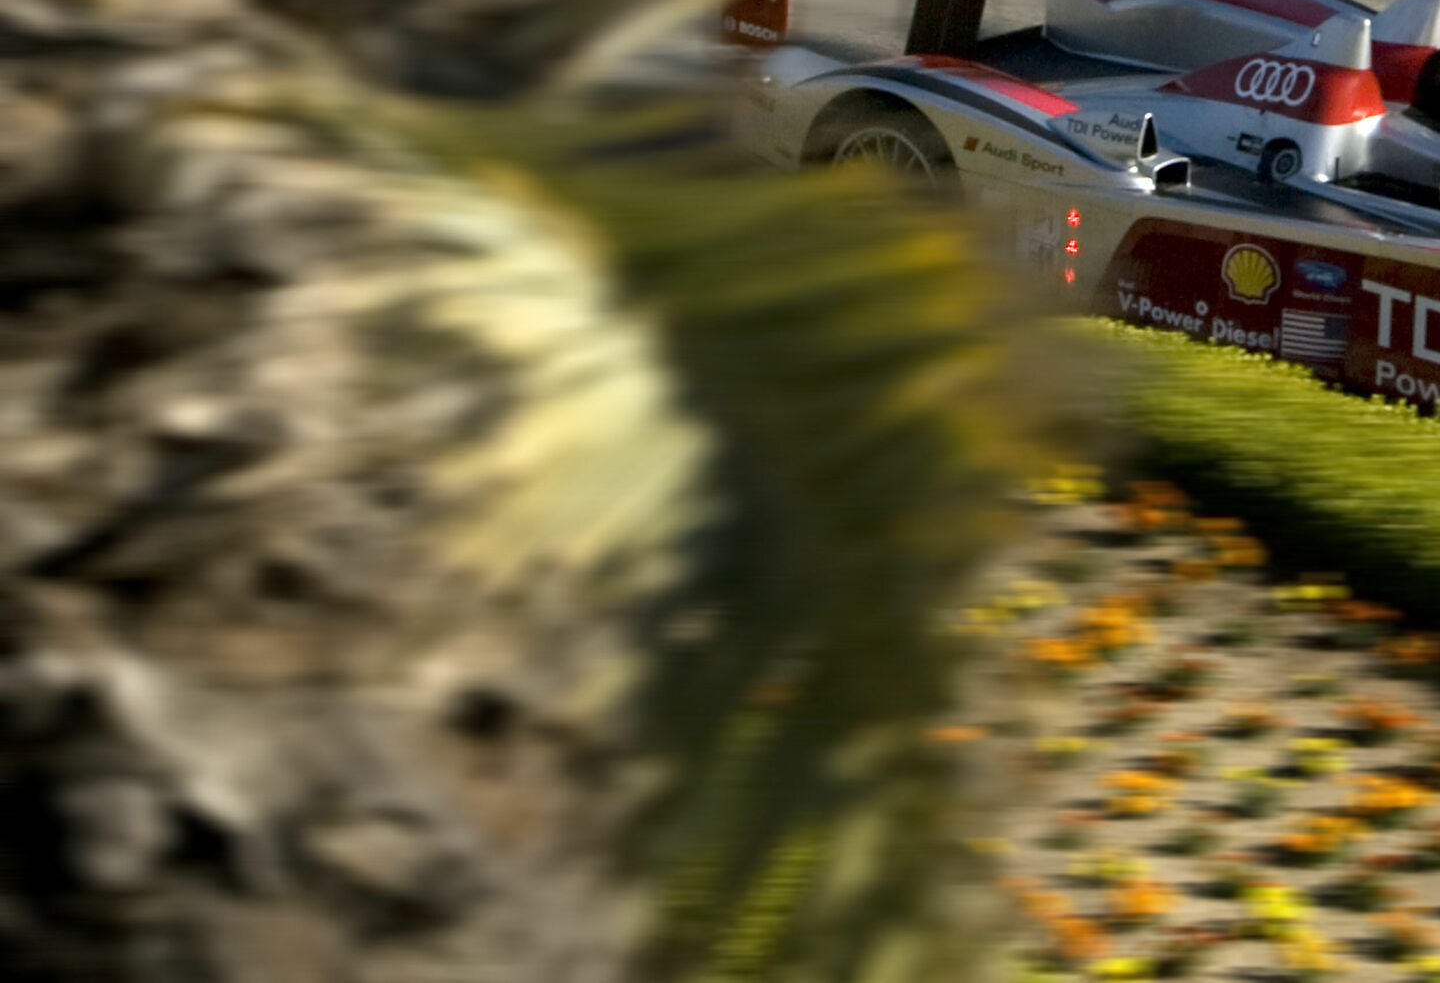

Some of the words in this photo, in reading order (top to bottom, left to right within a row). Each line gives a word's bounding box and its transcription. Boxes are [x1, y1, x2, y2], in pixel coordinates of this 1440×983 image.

[1067, 117, 1089, 135] TDI
[981, 141, 1018, 162] Audi
[1021, 153, 1065, 177] Sport
[1117, 291, 1203, 332] V-Power
[1212, 316, 1280, 350] Diesel
